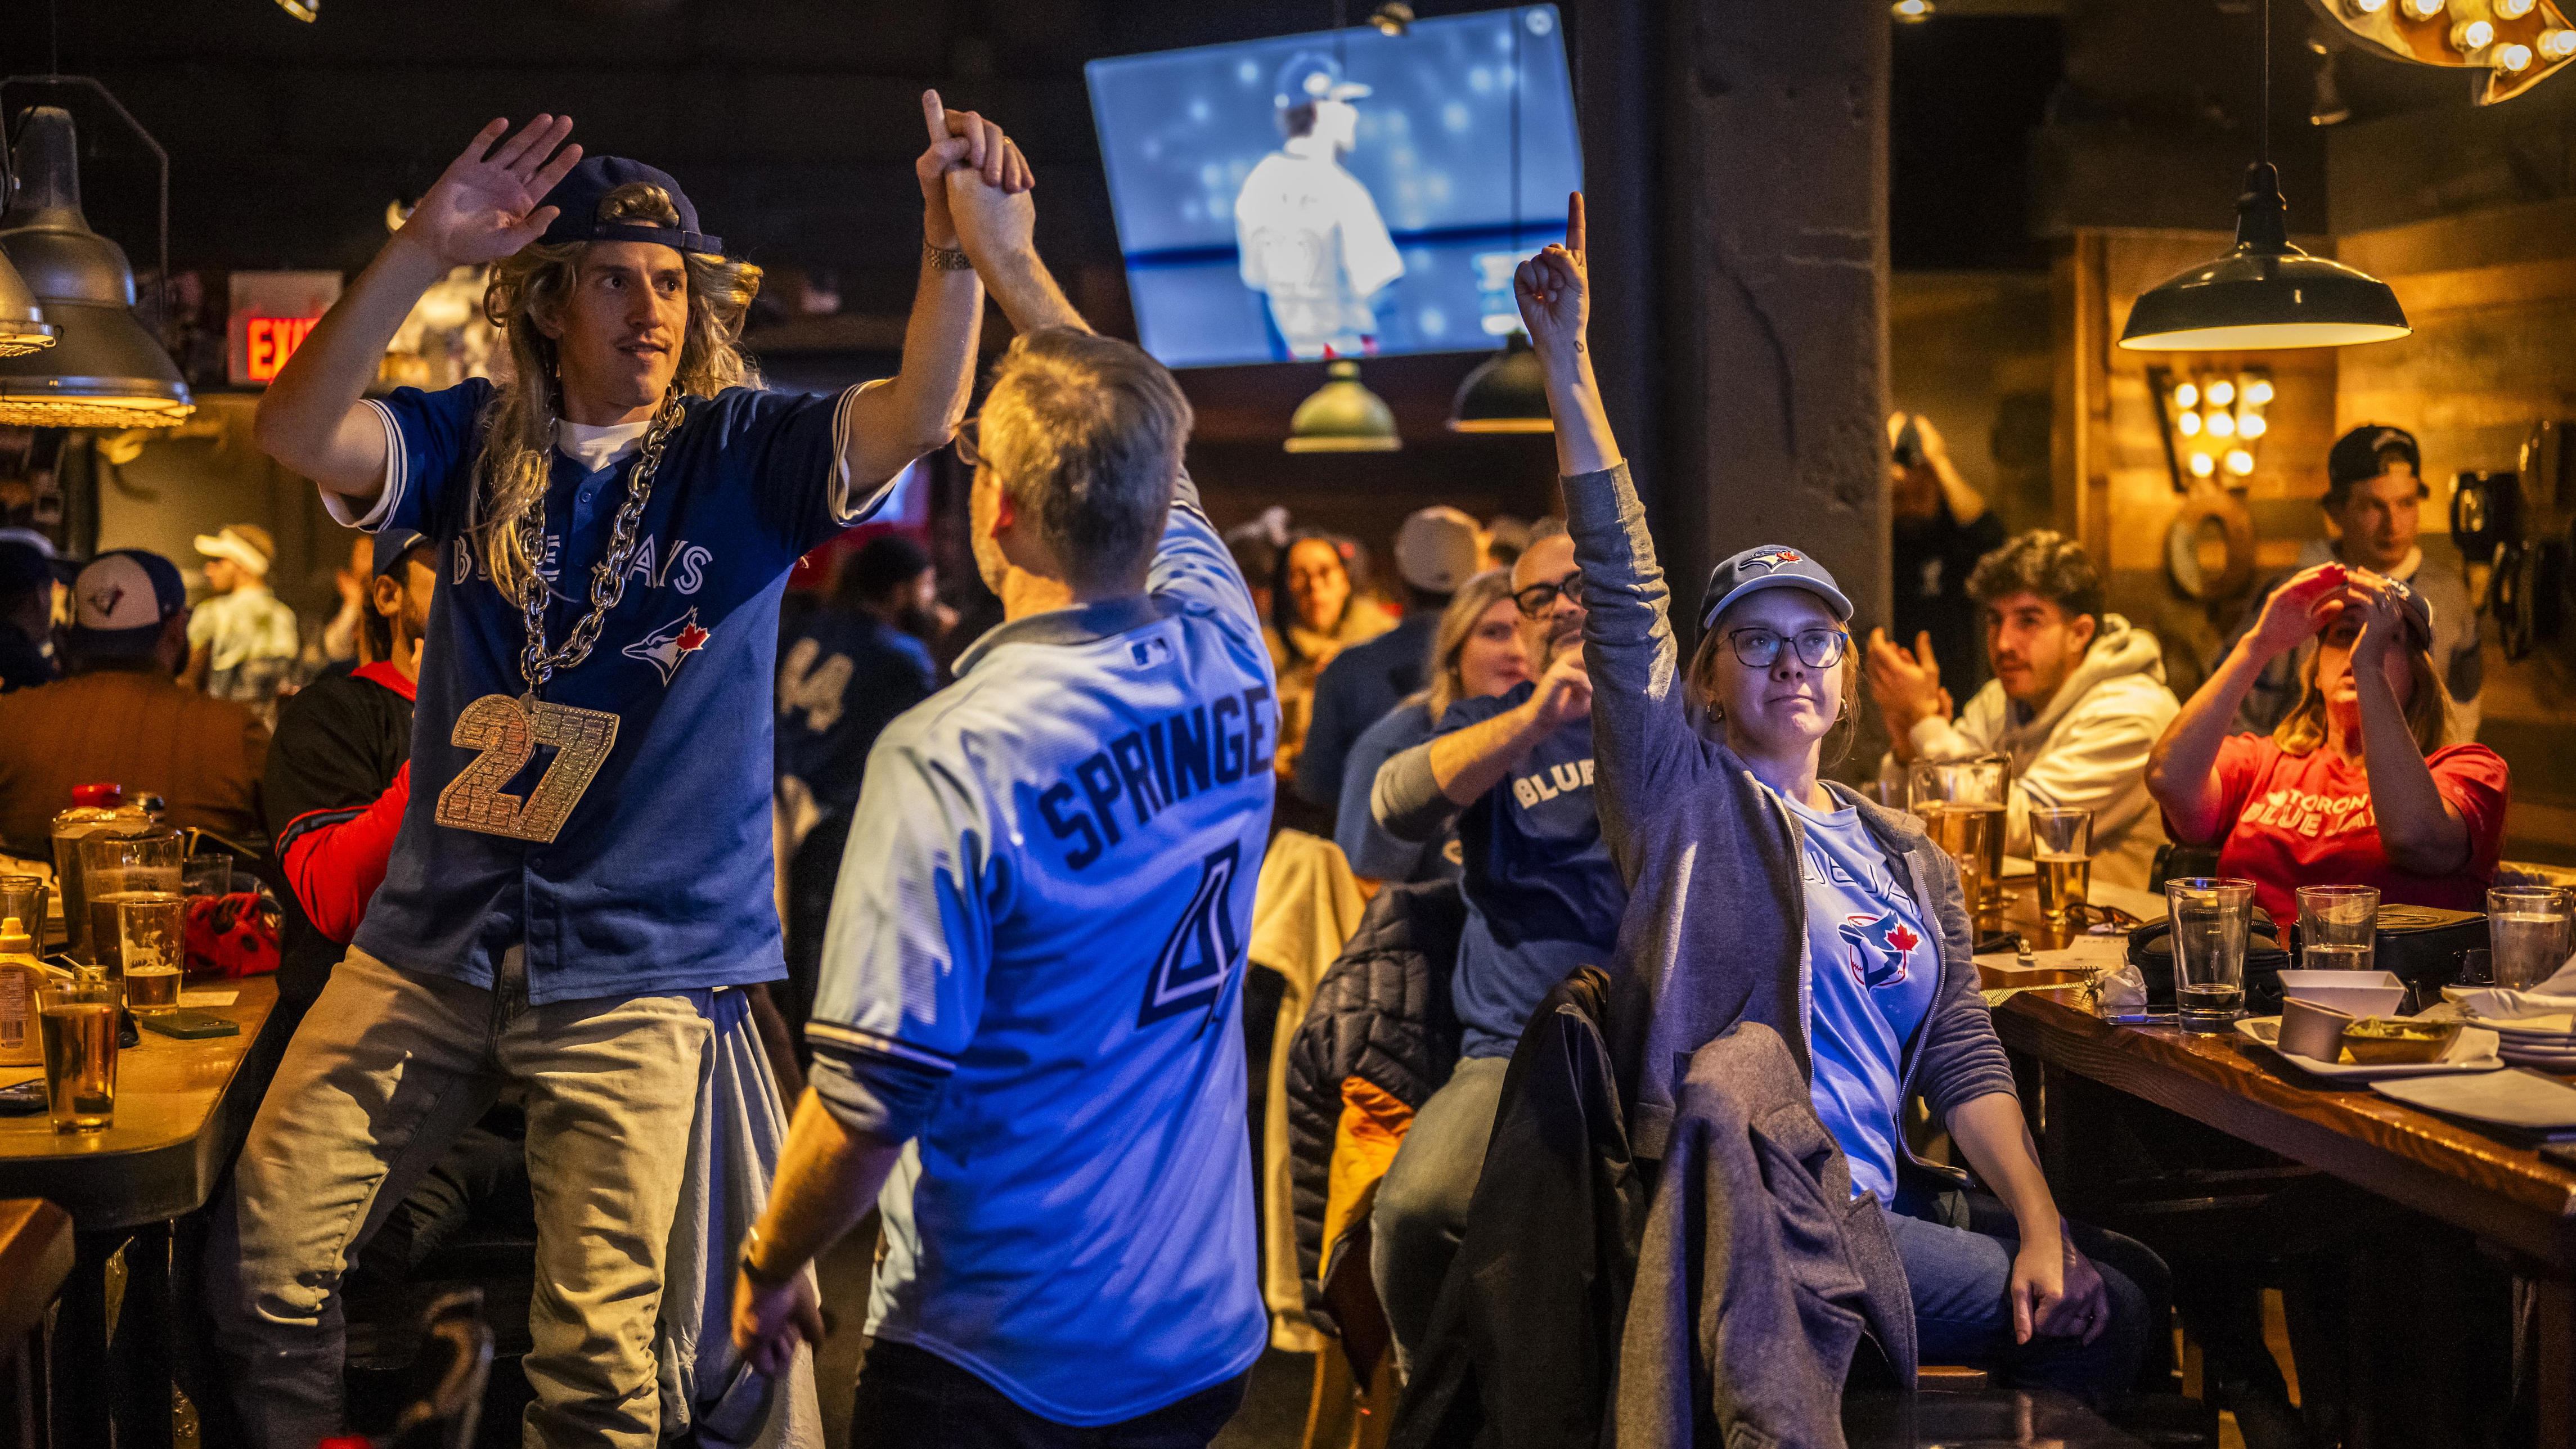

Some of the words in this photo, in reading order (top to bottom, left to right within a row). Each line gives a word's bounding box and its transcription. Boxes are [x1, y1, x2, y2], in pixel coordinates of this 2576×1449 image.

[434, 694, 621, 844] 27
[1039, 685, 1275, 871] SPRINGE
[2289, 789, 2368, 815] TORON
[1136, 838, 1240, 1041] 4
